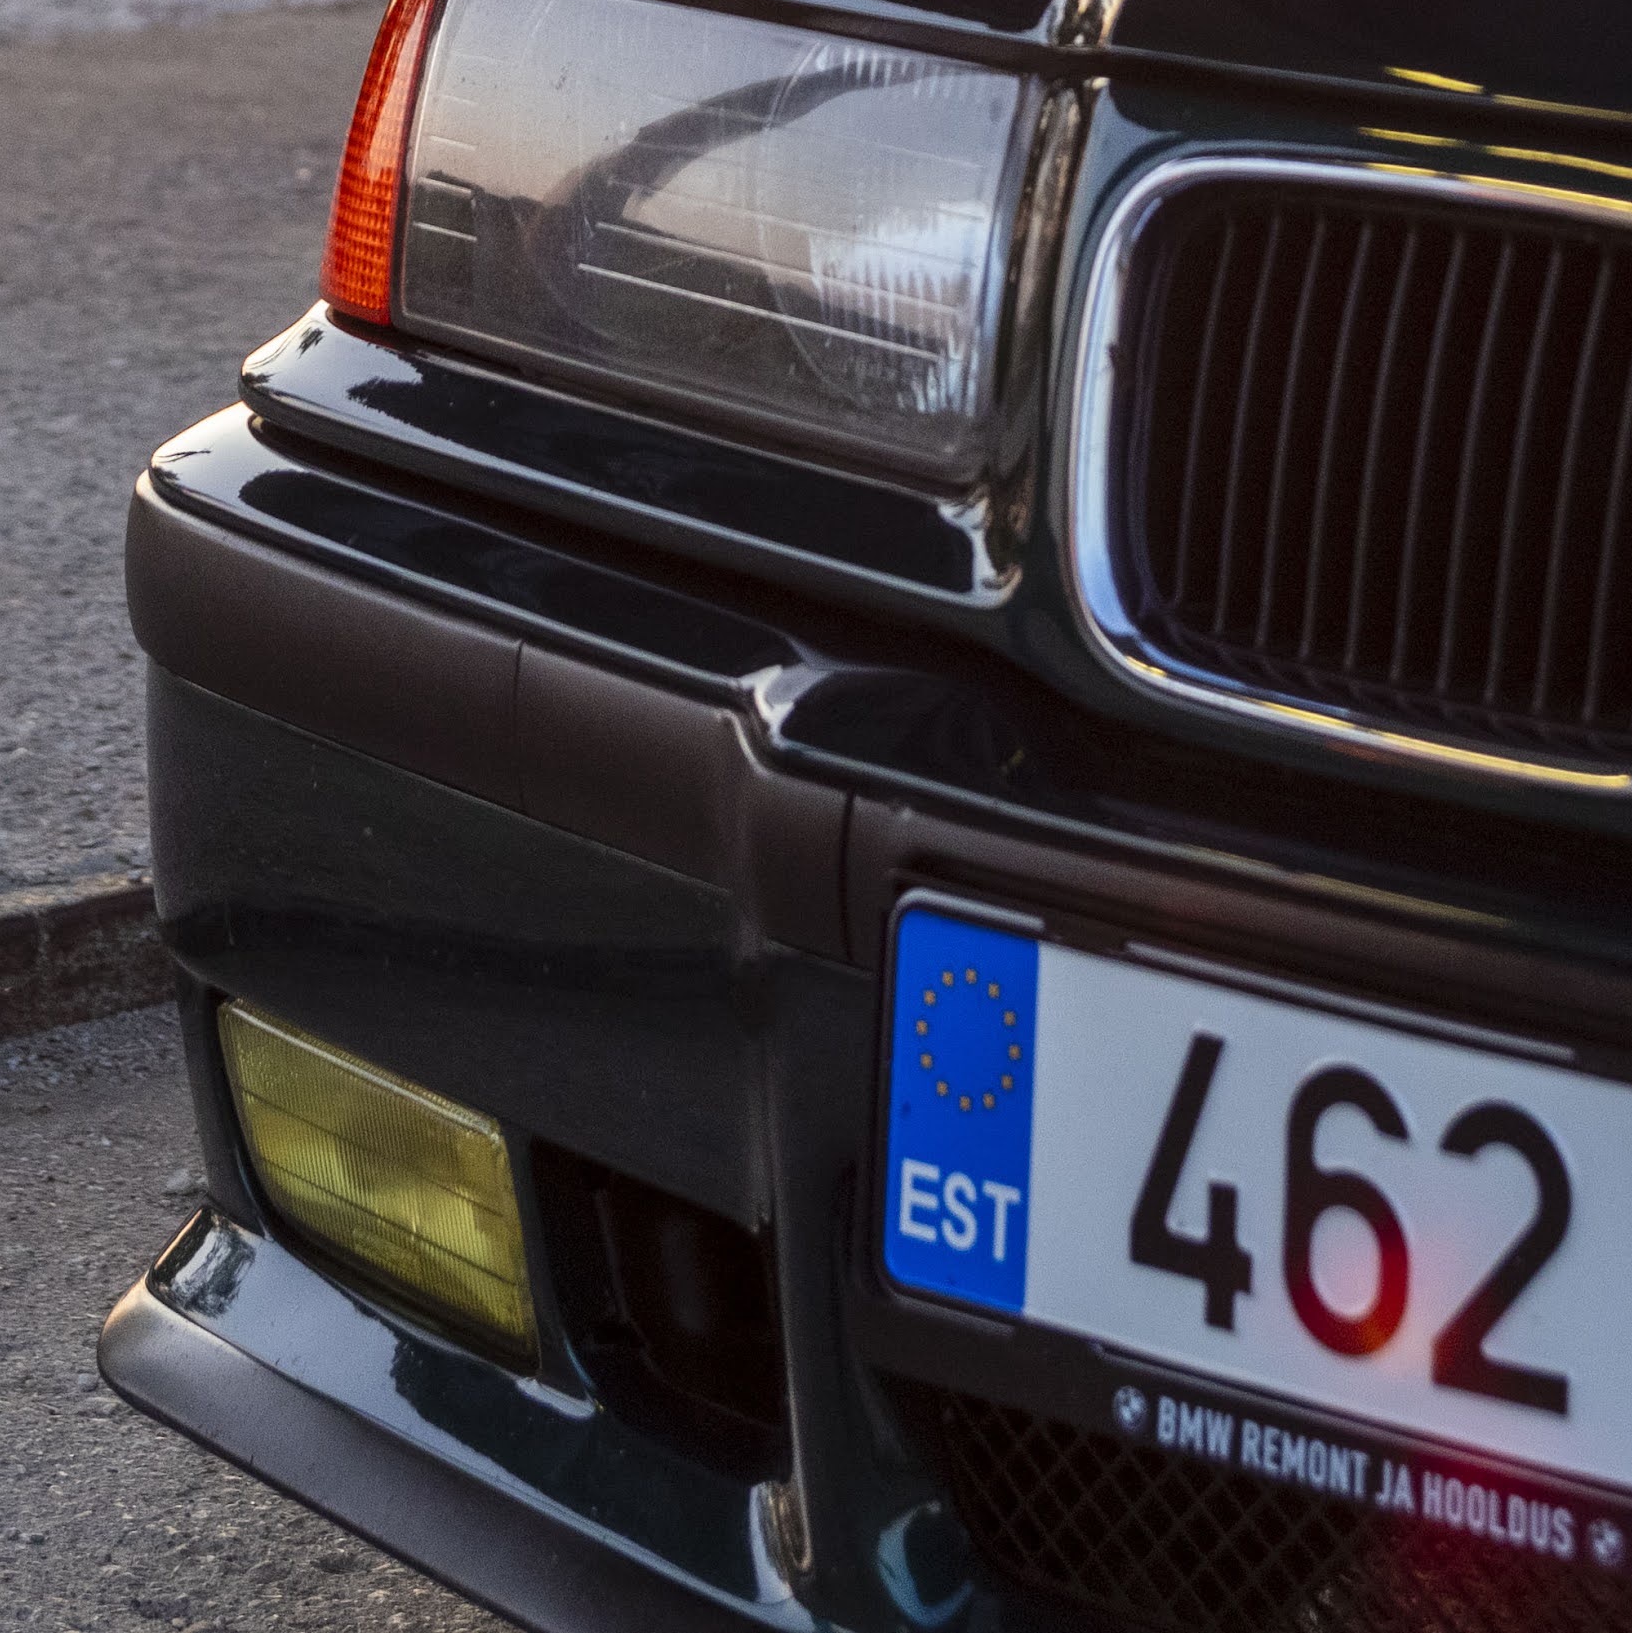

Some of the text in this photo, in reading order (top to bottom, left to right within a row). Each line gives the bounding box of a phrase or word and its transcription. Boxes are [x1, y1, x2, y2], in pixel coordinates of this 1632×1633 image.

[899, 1157, 1021, 1262] EST
[1127, 1029, 1572, 1417] 462
[1157, 1396, 1234, 1458] BMW
[1241, 1422, 1366, 1494] REMONT
[1375, 1463, 1415, 1513] JA
[1423, 1473, 1575, 1558] HOOLDUS
